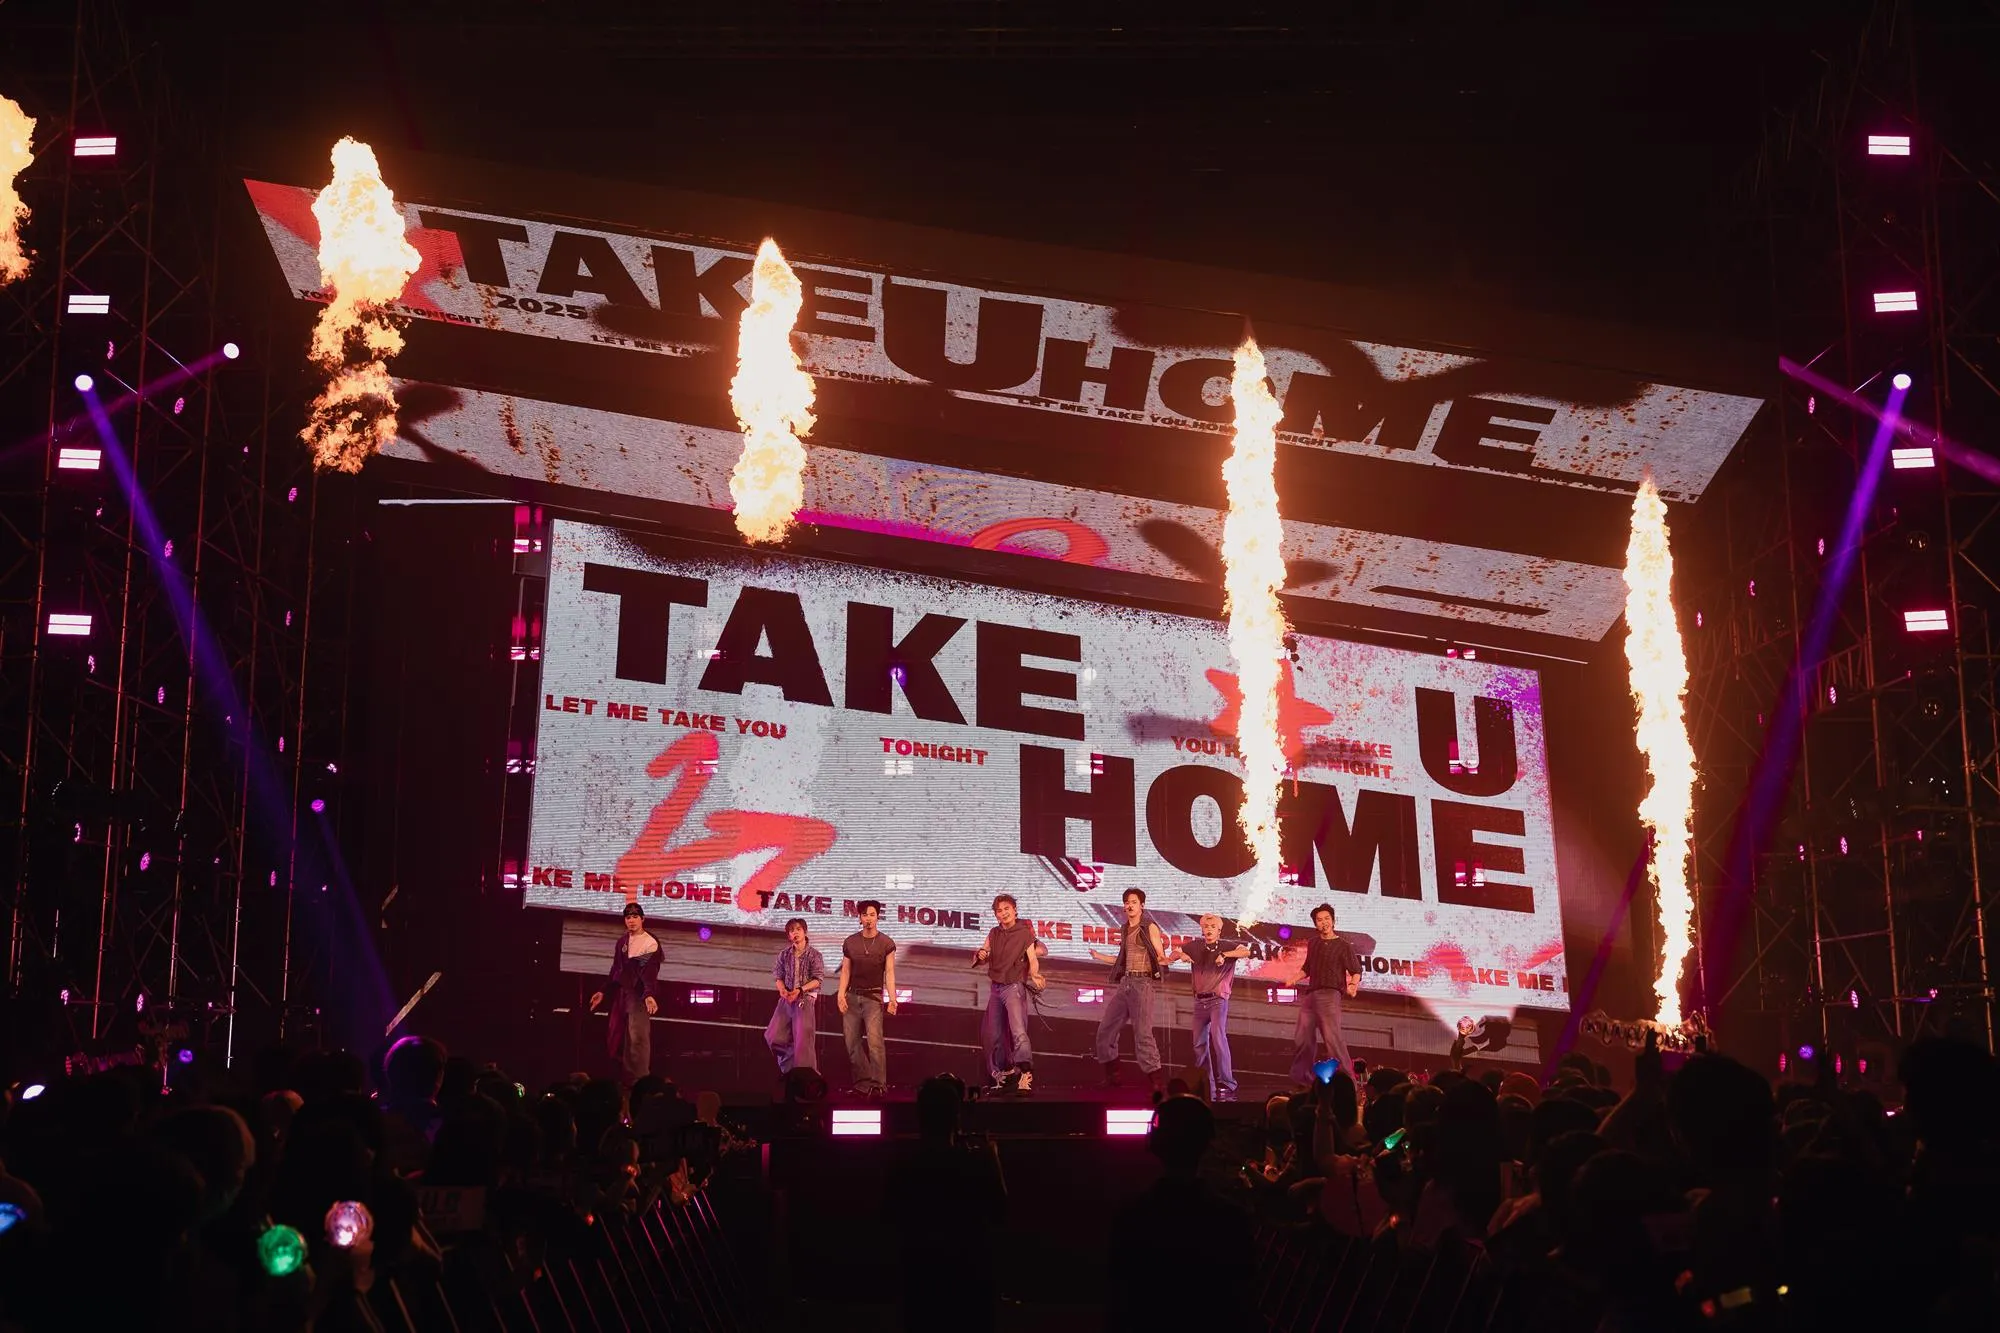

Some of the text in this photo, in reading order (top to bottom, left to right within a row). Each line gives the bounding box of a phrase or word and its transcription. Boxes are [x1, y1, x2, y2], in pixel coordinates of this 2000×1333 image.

[400, 305, 483, 325] TONIGHT
[497, 293, 589, 320] 2025
[418, 208, 1556, 468] TAKE U HOME
[590, 334, 627, 346] LET
[634, 340, 663, 351] ME
[1018, 398, 1058, 408] LET
[1060, 403, 1089, 414] ME
[1095, 408, 1145, 421] TAKE
[1151, 413, 1188, 426] YOU
[1277, 431, 1338, 448] NIGHT
[583, 562, 1086, 741] TAKE
[545, 694, 788, 740] LET ME TAKE YOU
[879, 737, 988, 766] TONIGHT
[1171, 736, 1216, 756] YOU
[1414, 687, 1518, 797] U
[1020, 744, 1536, 914] HOME
[584, 872, 628, 894] ME
[642, 880, 732, 905] HOME
[756, 889, 832, 915] TAKE
[897, 904, 980, 930] HOME
[1024, 919, 1073, 941] AKE
[1357, 955, 1430, 980] HOME
[1517, 972, 1555, 992] ME
